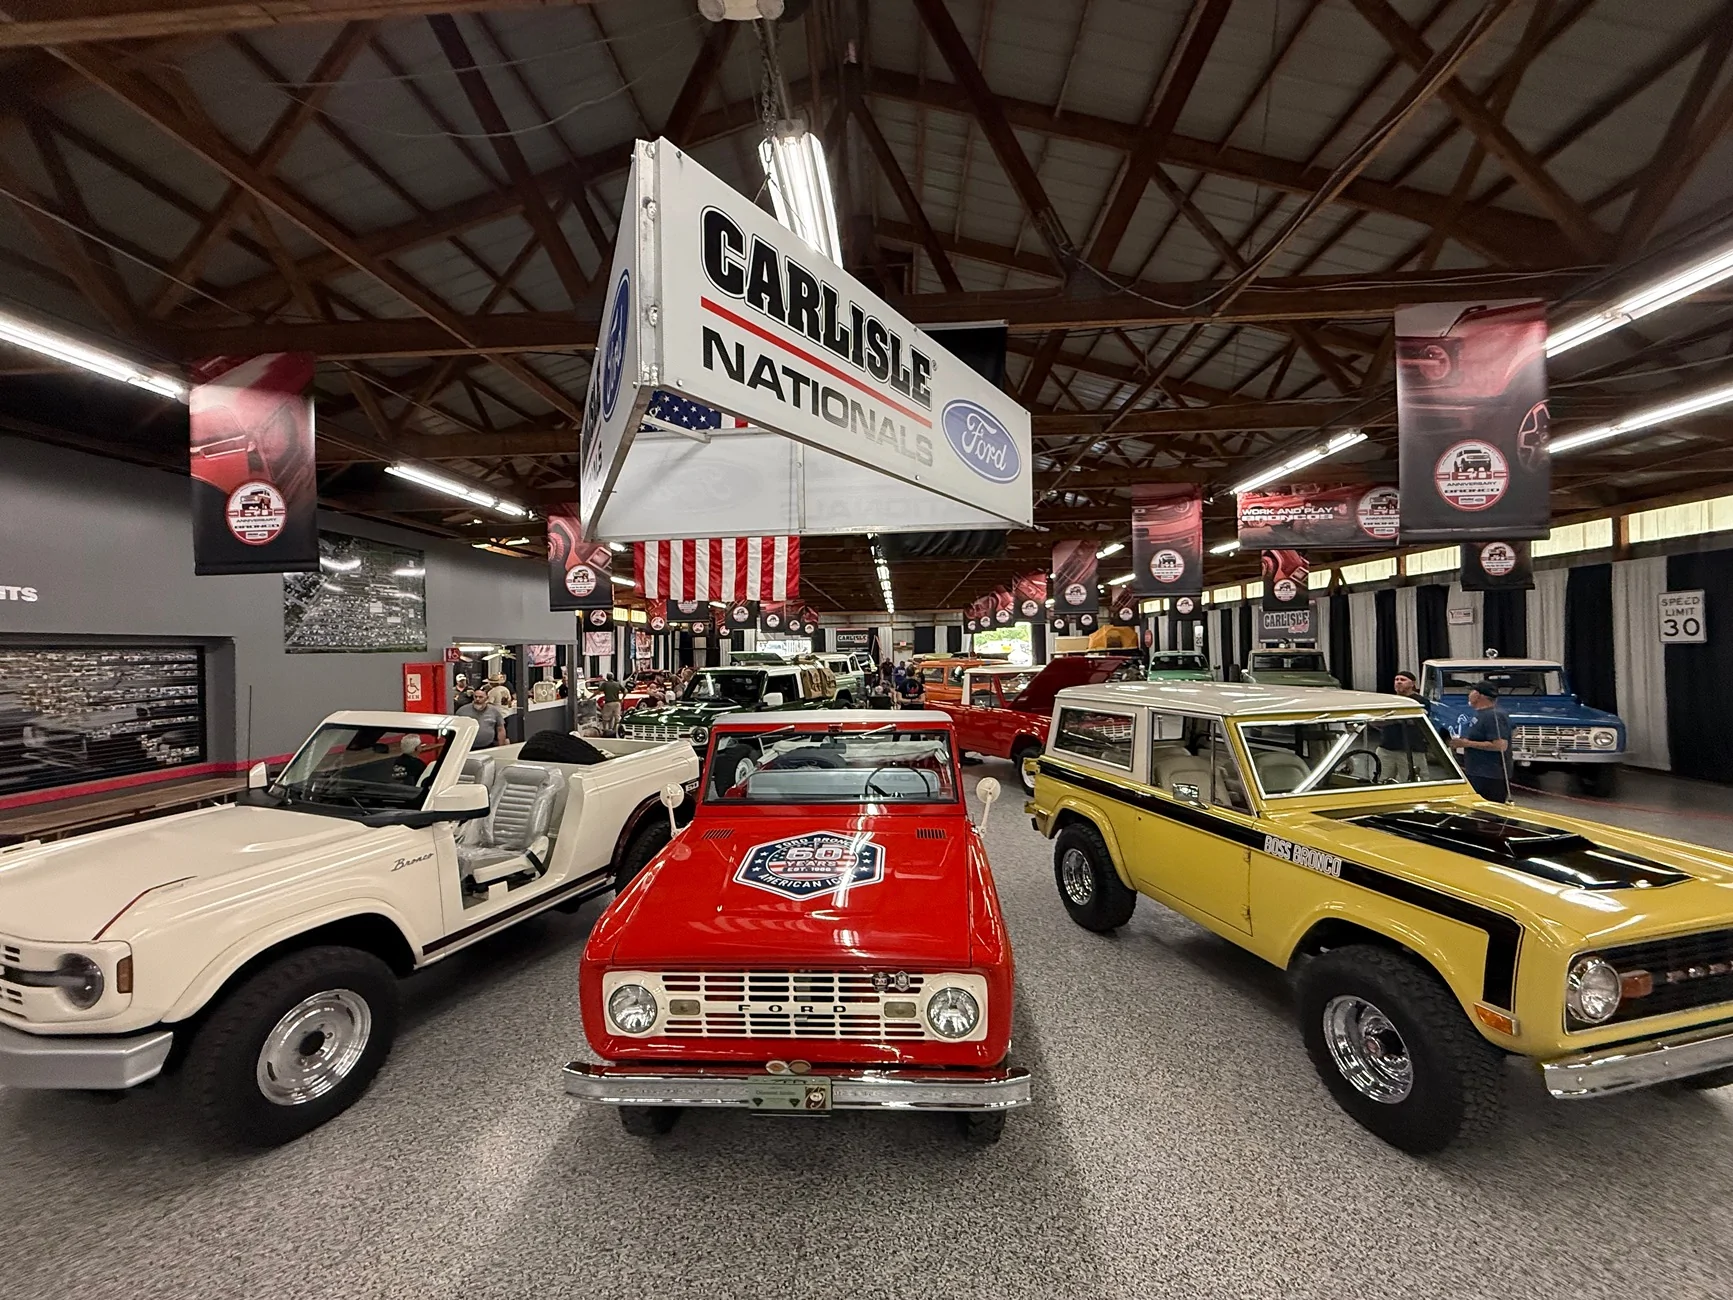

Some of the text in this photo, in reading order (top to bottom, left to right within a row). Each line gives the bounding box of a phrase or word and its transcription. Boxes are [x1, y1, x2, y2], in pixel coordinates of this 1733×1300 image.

[701, 205, 933, 412] CARLISLE
[702, 325, 934, 468] NATIONALS
[961, 412, 1008, 472] Ford
[1241, 506, 1333, 516] WORK AND PLAY
[1661, 596, 1701, 607] SPEED
[1263, 610, 1310, 629] CARLISLE
[1665, 607, 1695, 617] LIMIT
[1663, 617, 1700, 637] 30
[390, 852, 434, 872] Bronco
[786, 847, 843, 860] 60
[1263, 834, 1342, 878] BOSS BRONCO
[758, 873, 822, 888] AMERICAN
[738, 1004, 847, 1013] FORD
